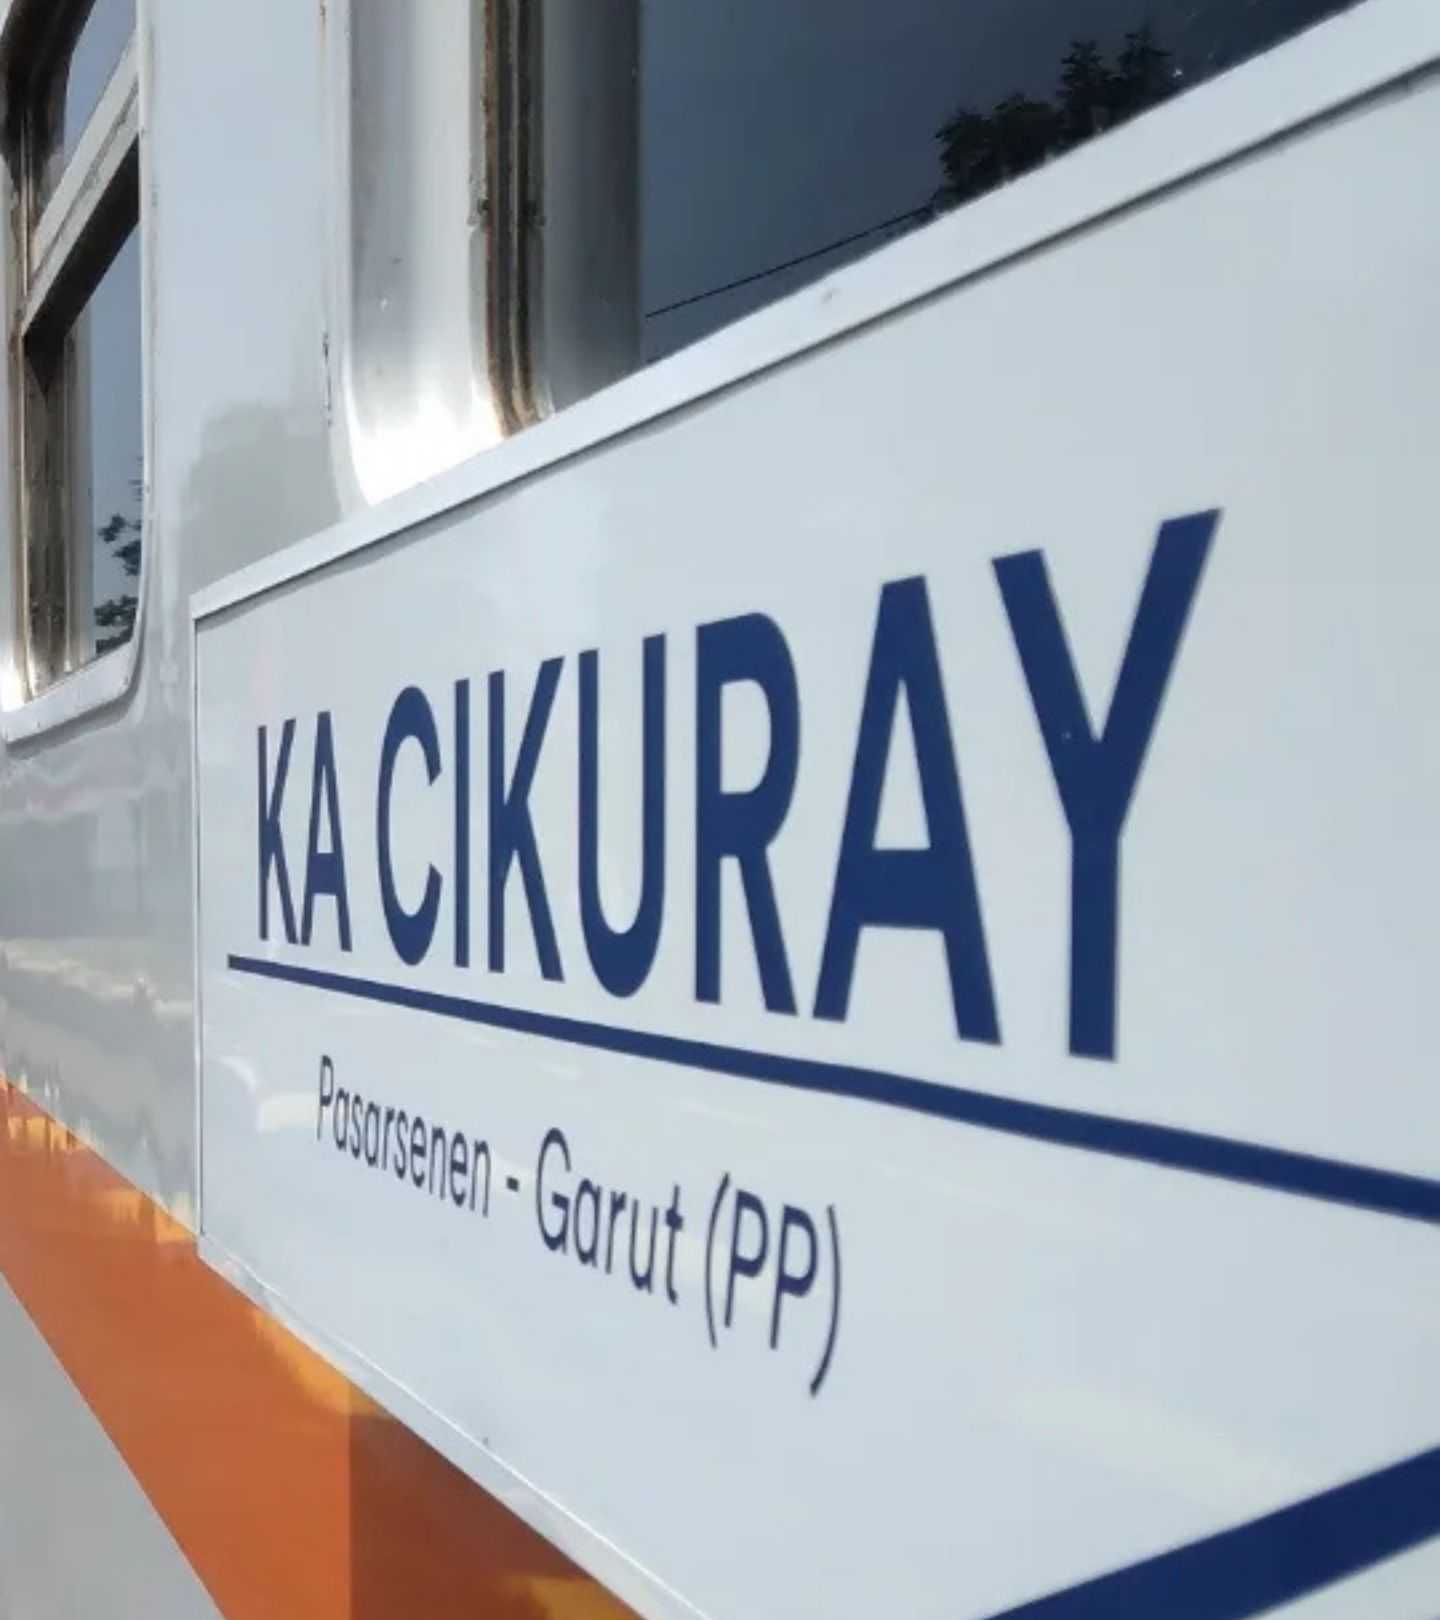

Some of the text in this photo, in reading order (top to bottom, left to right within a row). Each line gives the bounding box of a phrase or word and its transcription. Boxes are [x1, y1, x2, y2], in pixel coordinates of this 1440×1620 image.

[257, 507, 1222, 1063] KA CIKURAY
[318, 1054, 841, 1397] Pasarsenen - Garut (PP)
